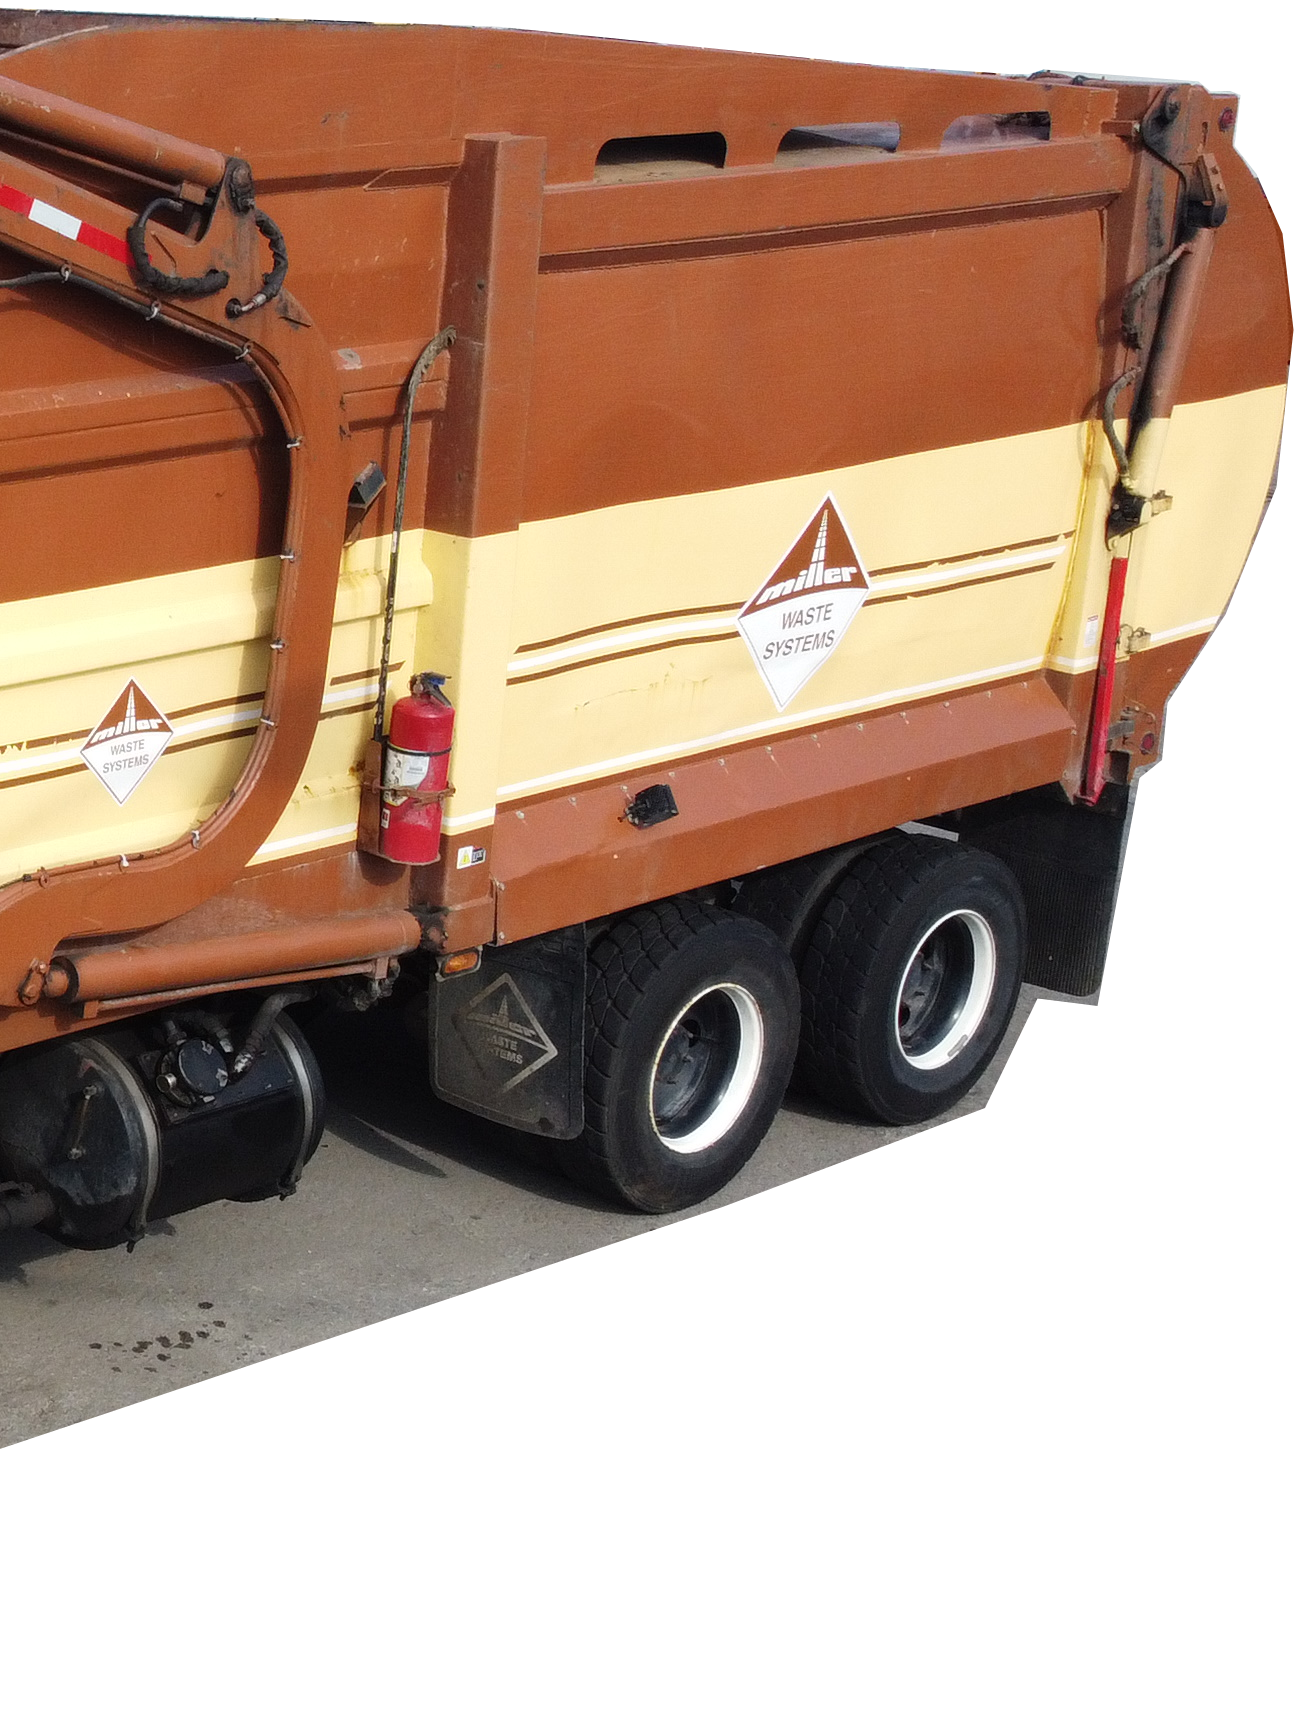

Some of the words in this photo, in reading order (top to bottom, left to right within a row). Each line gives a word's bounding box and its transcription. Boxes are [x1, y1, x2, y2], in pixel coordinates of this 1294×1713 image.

[781, 602, 834, 630] WASTE
[763, 629, 836, 660] SYSTEMS
[110, 739, 145, 756] WASTE
[102, 754, 149, 774] SYSTEMS
